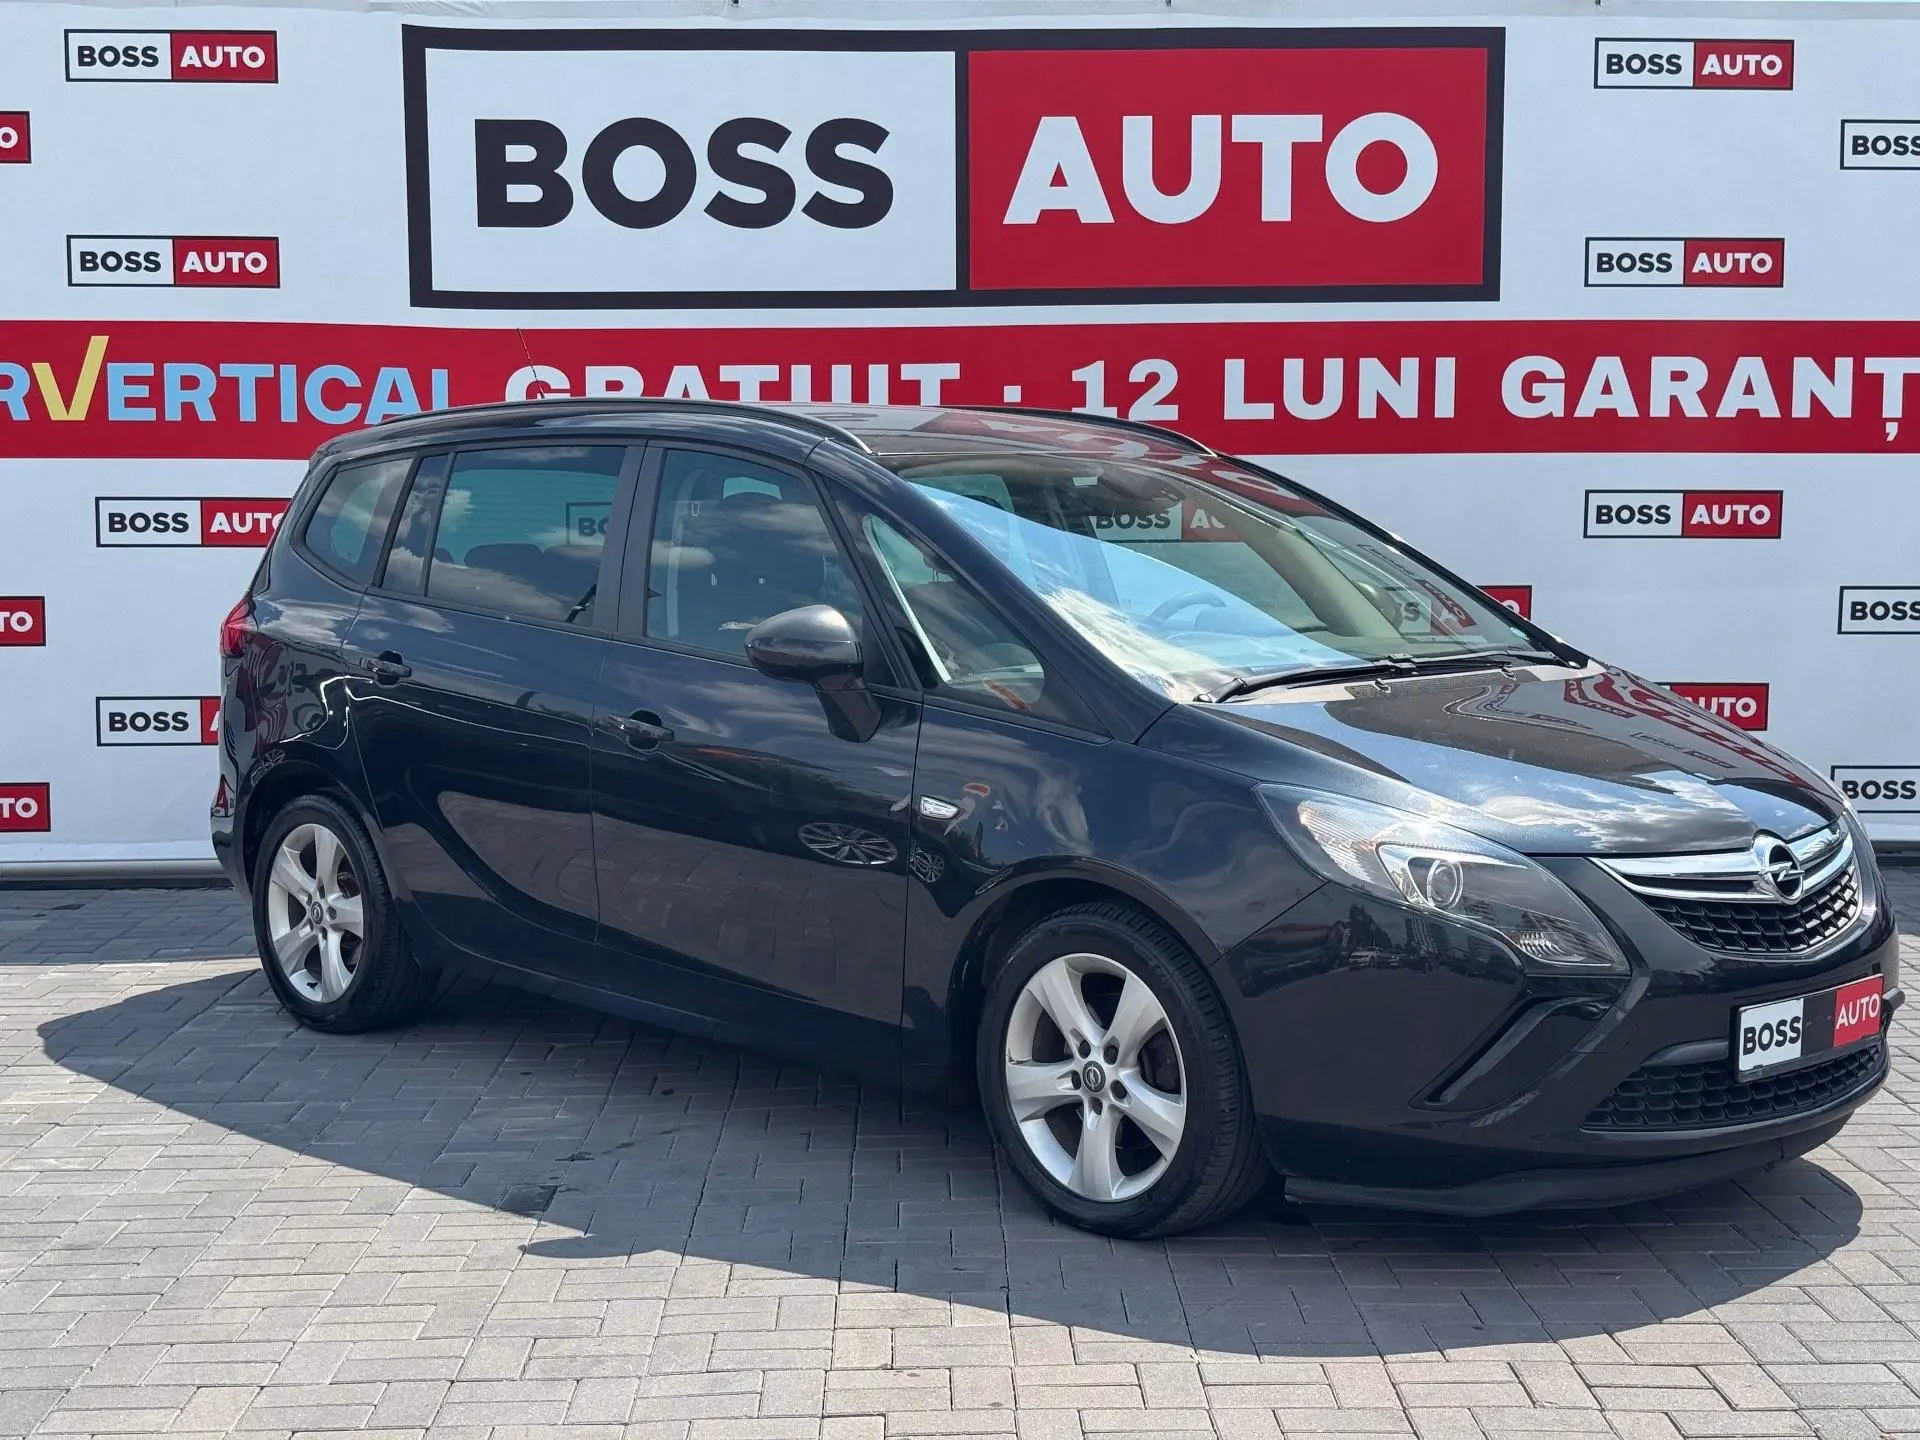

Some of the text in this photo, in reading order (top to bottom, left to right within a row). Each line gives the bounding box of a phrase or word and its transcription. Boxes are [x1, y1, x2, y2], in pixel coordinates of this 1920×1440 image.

[77, 45, 266, 69] BOSS AUTO
[1606, 53, 1783, 76] BOSS AUTO
[475, 112, 1438, 230] BOSS AUTO
[80, 250, 268, 274] BOSS AUTO
[1596, 252, 1773, 274] BOSS AUTO
[1072, 358, 1179, 421] 12
[1224, 357, 1456, 420] LUNI
[108, 512, 190, 534] BOSS
[1595, 504, 1771, 525] BOSS AUTO
[1850, 600, 1920, 621] BOSS
[1684, 696, 1757, 718] UTO
[108, 711, 190, 733] BOSS
[1842, 780, 1917, 800] BOSS
[1742, 993, 1881, 1056] BOSS AUTO
